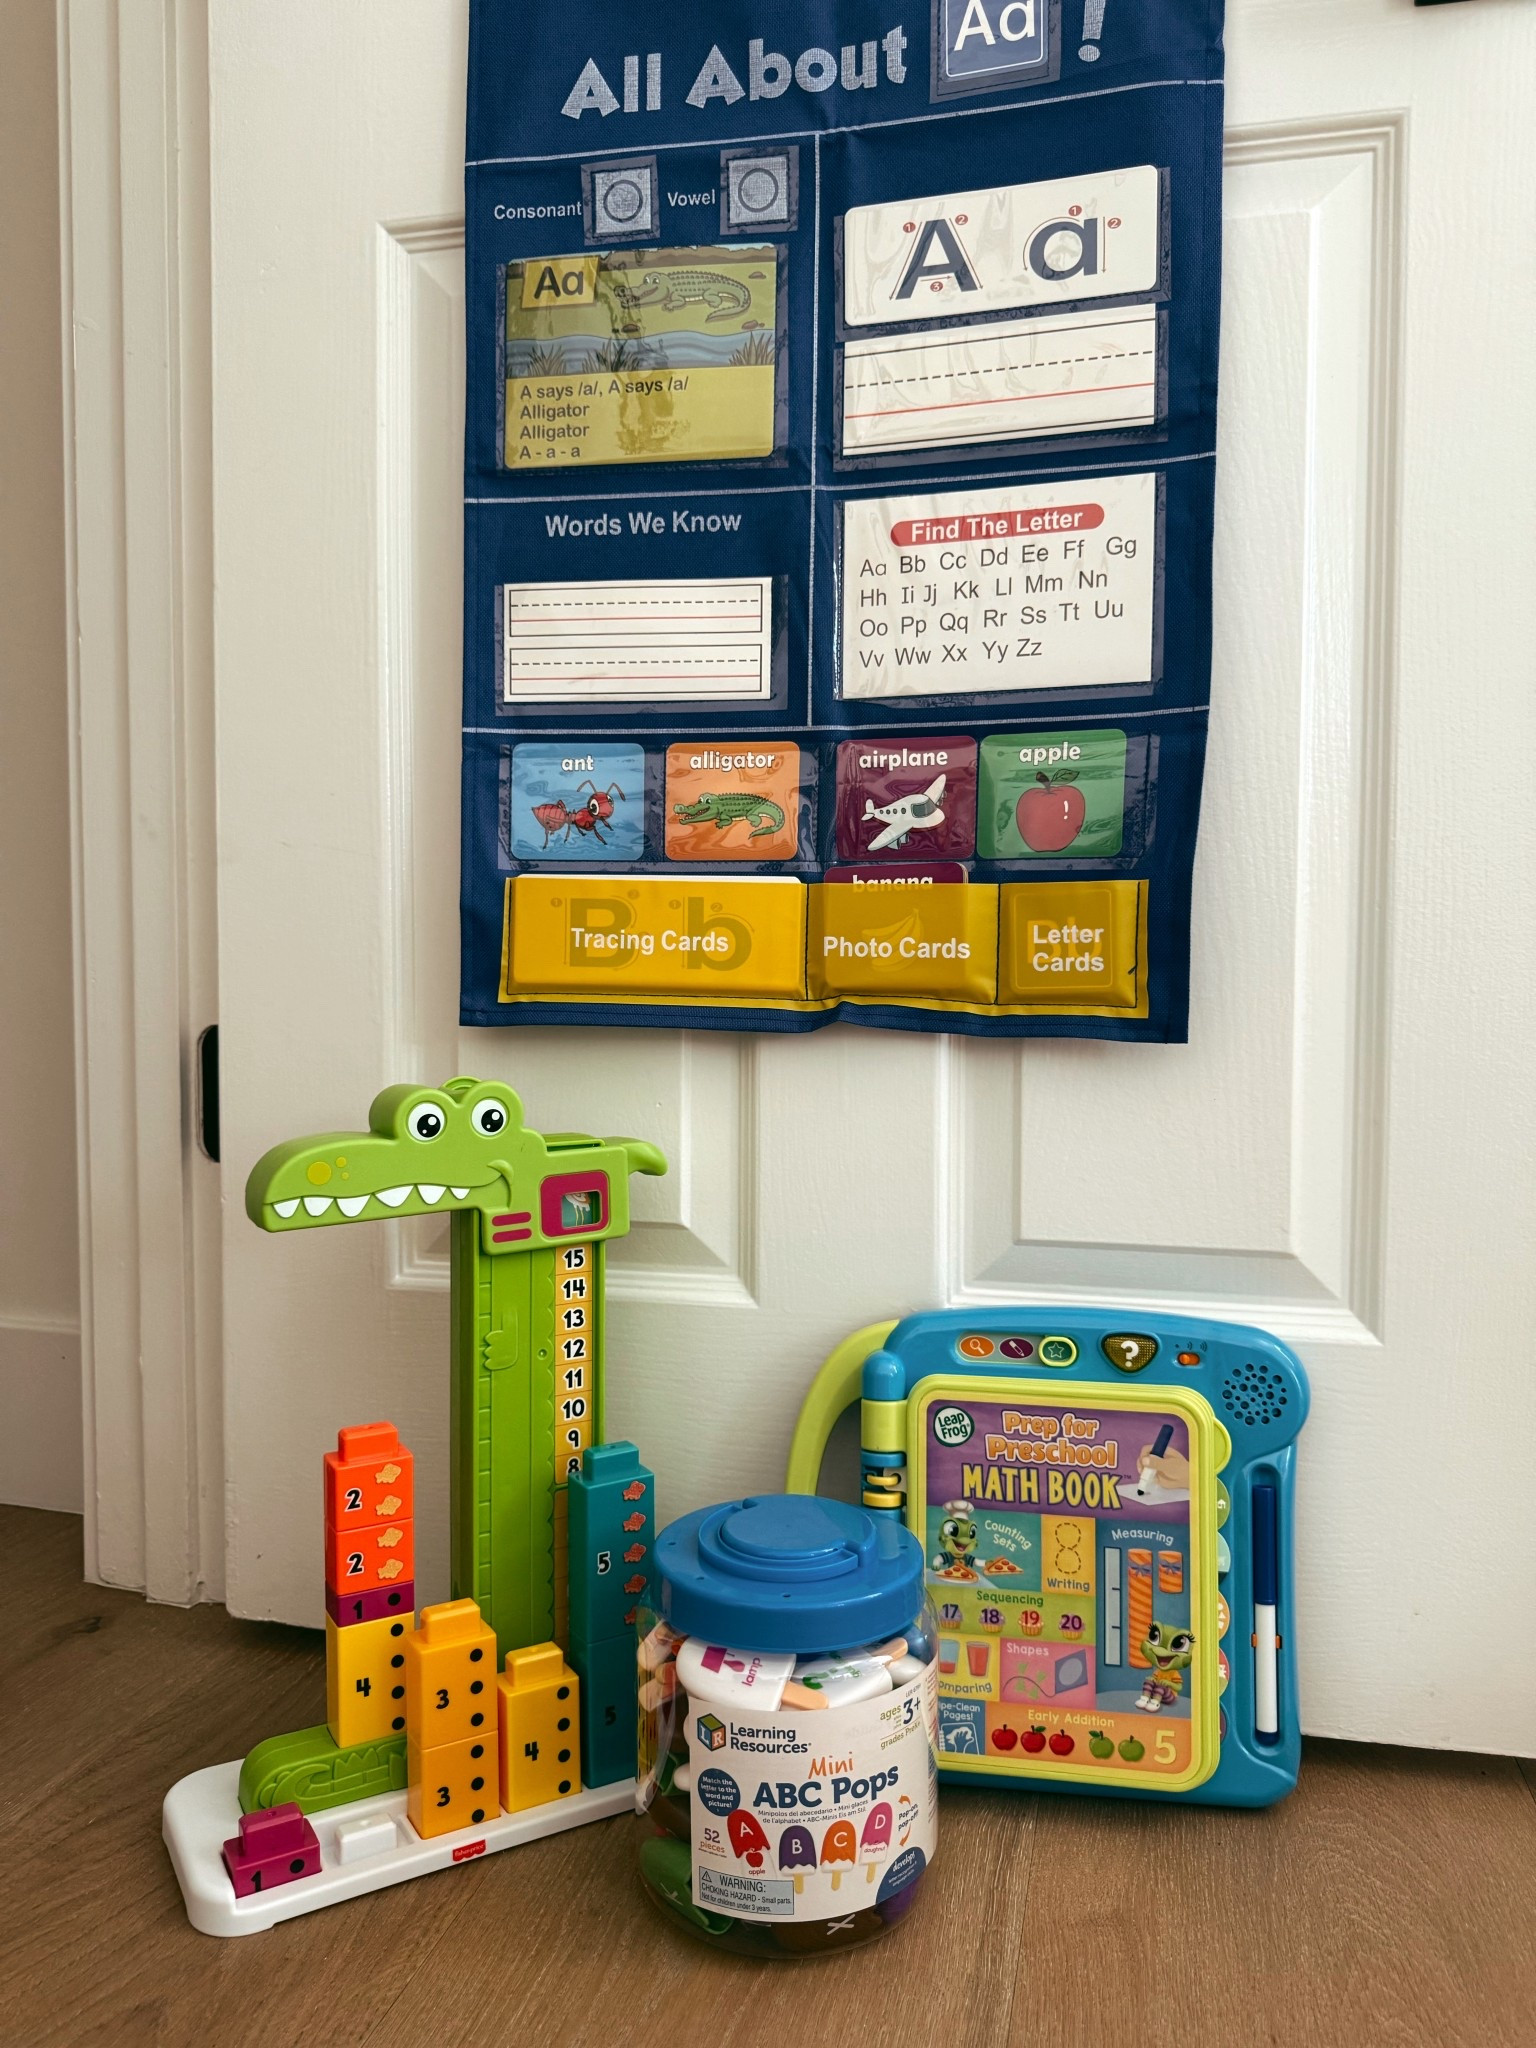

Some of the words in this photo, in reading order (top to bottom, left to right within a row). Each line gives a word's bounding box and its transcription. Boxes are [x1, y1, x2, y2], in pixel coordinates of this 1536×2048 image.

[561, 53, 661, 119] All
[685, 22, 907, 108] About
[1078, 0, 1106, 62] !
[667, 189, 716, 207] Vowel
[494, 201, 582, 220] Consonant
[895, 219, 978, 300] A
[1029, 218, 1098, 281] a
[533, 266, 584, 299] Aa
[520, 385, 532, 399] A
[537, 385, 574, 401] says
[608, 383, 620, 394] A
[625, 380, 663, 396] says
[667, 376, 689, 391] /a/
[520, 403, 590, 422] Alligator
[520, 424, 590, 441] Alligator
[519, 446, 531, 460] A
[546, 447, 556, 459] a
[571, 446, 581, 457] a
[545, 513, 622, 537] Words
[628, 511, 666, 534] We
[672, 510, 742, 533] Know
[911, 519, 959, 542] Find
[967, 516, 1008, 537] The
[1016, 509, 1083, 533] Letter
[859, 559, 887, 578] Aa
[899, 555, 926, 574] Bb
[939, 552, 967, 571] Cc
[980, 547, 1008, 567] Dd
[1021, 544, 1049, 563] Ee
[1063, 539, 1085, 559] Ff
[1106, 536, 1137, 559] Gg
[860, 588, 887, 607] Hh
[901, 585, 915, 604] Ii
[923, 584, 937, 606] Jj
[953, 580, 979, 599] Kk
[995, 577, 1012, 596] Ll
[1025, 574, 1063, 594] Mm
[1078, 570, 1108, 589] Nn
[859, 618, 888, 637] Oo
[901, 616, 927, 637] Pp
[939, 612, 969, 634] Qq
[983, 609, 1007, 628] Rr
[1020, 606, 1047, 625] Ss
[1059, 603, 1080, 621] Tt
[1094, 599, 1124, 619] Uu
[859, 650, 885, 668] Vv
[895, 647, 931, 665] Ww
[941, 644, 968, 663] Xx
[982, 641, 1008, 663] Yy
[1016, 639, 1042, 657] Zz
[561, 755, 594, 771] ant
[689, 751, 775, 772] alligator
[858, 748, 948, 771] airplane
[1019, 742, 1081, 766] apple
[853, 874, 934, 889] banana
[571, 927, 655, 956] Tracing
[661, 930, 729, 952] Cards
[1033, 924, 1104, 944] Letter
[823, 936, 893, 958] Photo
[899, 935, 971, 959] Cards
[1032, 951, 1105, 972] Cards
[563, 1249, 585, 1269] 15
[562, 1278, 586, 1299] 14
[562, 1308, 586, 1329] 13
[562, 1338, 586, 1359] 12
[1121, 1340, 1139, 1367] ?
[563, 1368, 584, 1389] 11
[562, 1398, 586, 1420] 10
[938, 1412, 965, 1428] Leap
[1002, 1410, 1058, 1438] Prep
[1063, 1413, 1100, 1438] for
[566, 1428, 581, 1449] 9
[985, 1434, 1118, 1468] Preschool
[962, 1463, 1038, 1503] MATH
[1048, 1469, 1123, 1509] BOOK
[346, 1488, 363, 1512] 2
[984, 1519, 1033, 1551] Counting
[993, 1533, 1017, 1552] Sets
[1111, 1528, 1174, 1547] Measuring
[346, 1552, 364, 1576] 2
[597, 1551, 611, 1575] 5
[1047, 1577, 1091, 1592] Writing
[976, 1590, 1044, 1607] Sequencing
[352, 1600, 363, 1620] 1
[942, 1603, 959, 1619] 17
[981, 1608, 1001, 1624] 18
[1021, 1610, 1040, 1626] 19
[1061, 1614, 1082, 1630] 20
[1006, 1643, 1049, 1656] Shapes
[742, 1657, 763, 1687] lamp
[356, 1677, 371, 1697] 4
[939, 1681, 992, 1694] omparing
[435, 1689, 450, 1709] 3
[604, 1705, 616, 1726] 5
[880, 1704, 901, 1721] ages
[903, 1697, 921, 1725] 3+
[943, 1710, 973, 1721] Pages!
[1028, 1709, 1060, 1725] Early
[1065, 1713, 1115, 1728] Addition
[730, 1722, 796, 1742] Learning
[880, 1732, 904, 1751] grades
[525, 1741, 539, 1762] 4
[1153, 1730, 1177, 1765] 5
[808, 1751, 853, 1779] Mini
[702, 1776, 721, 1785] Match
[753, 1781, 822, 1809] ABC
[831, 1766, 899, 1804] Pops
[436, 1786, 450, 1807] 3
[705, 1792, 720, 1800] word
[740, 1821, 754, 1838] A
[874, 1814, 886, 1829] D
[704, 1827, 720, 1843] 52
[791, 1832, 803, 1854] B
[834, 1831, 848, 1847] C
[700, 1841, 725, 1854] pieces
[250, 1870, 262, 1893] 1
[748, 1868, 766, 1876] apple
[701, 1882, 729, 1898] CHOKING
[730, 1891, 757, 1903] HAZARD
[761, 1896, 776, 1904] Small
[720, 1875, 766, 1893] WARNING:
